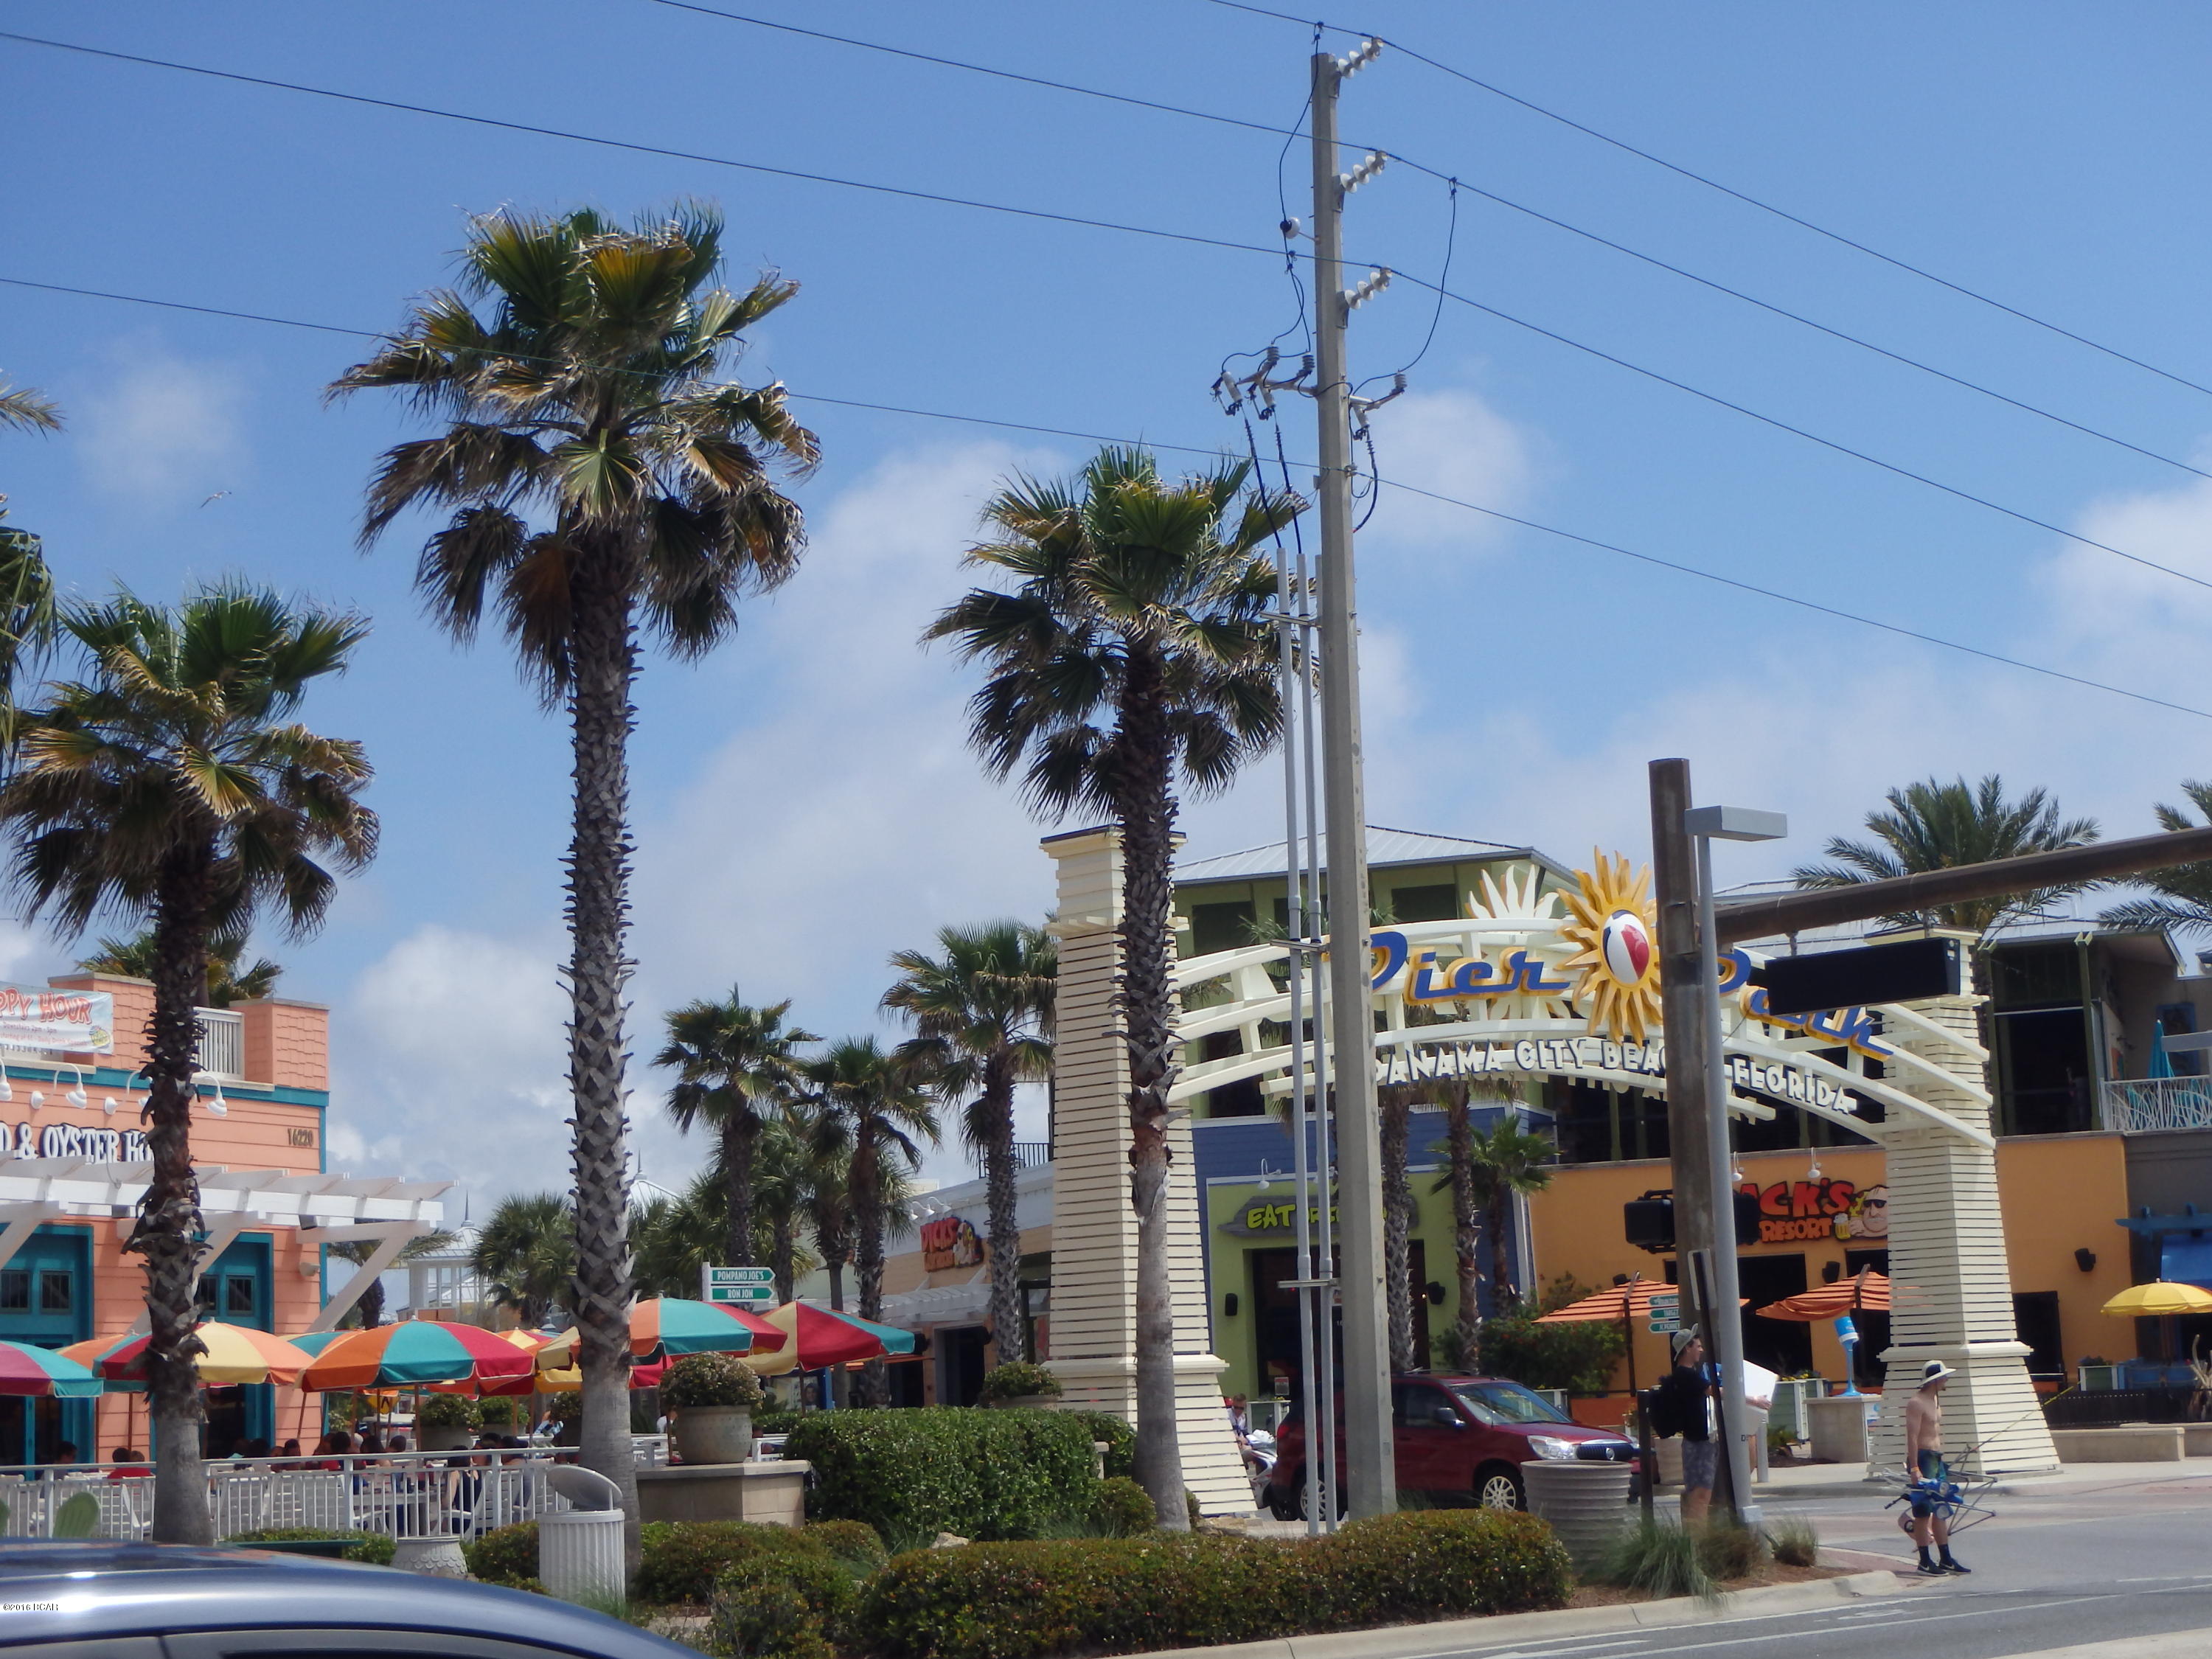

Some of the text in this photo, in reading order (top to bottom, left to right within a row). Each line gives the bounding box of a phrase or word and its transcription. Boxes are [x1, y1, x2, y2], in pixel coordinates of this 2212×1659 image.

[38, 990, 92, 1025] HOUR
[1515, 1039, 1587, 1070] CITY
[1733, 1057, 1850, 1114] FLORIDA
[15, 1121, 38, 1160] &
[42, 1122, 120, 1164] OYSTER
[288, 1127, 314, 1147] 16220
[1247, 1203, 1295, 1229] EAT
[1759, 1217, 1833, 1243] RESORT
[717, 1270, 764, 1281] POMPANO JOE'S
[727, 1288, 754, 1298] RON JON
